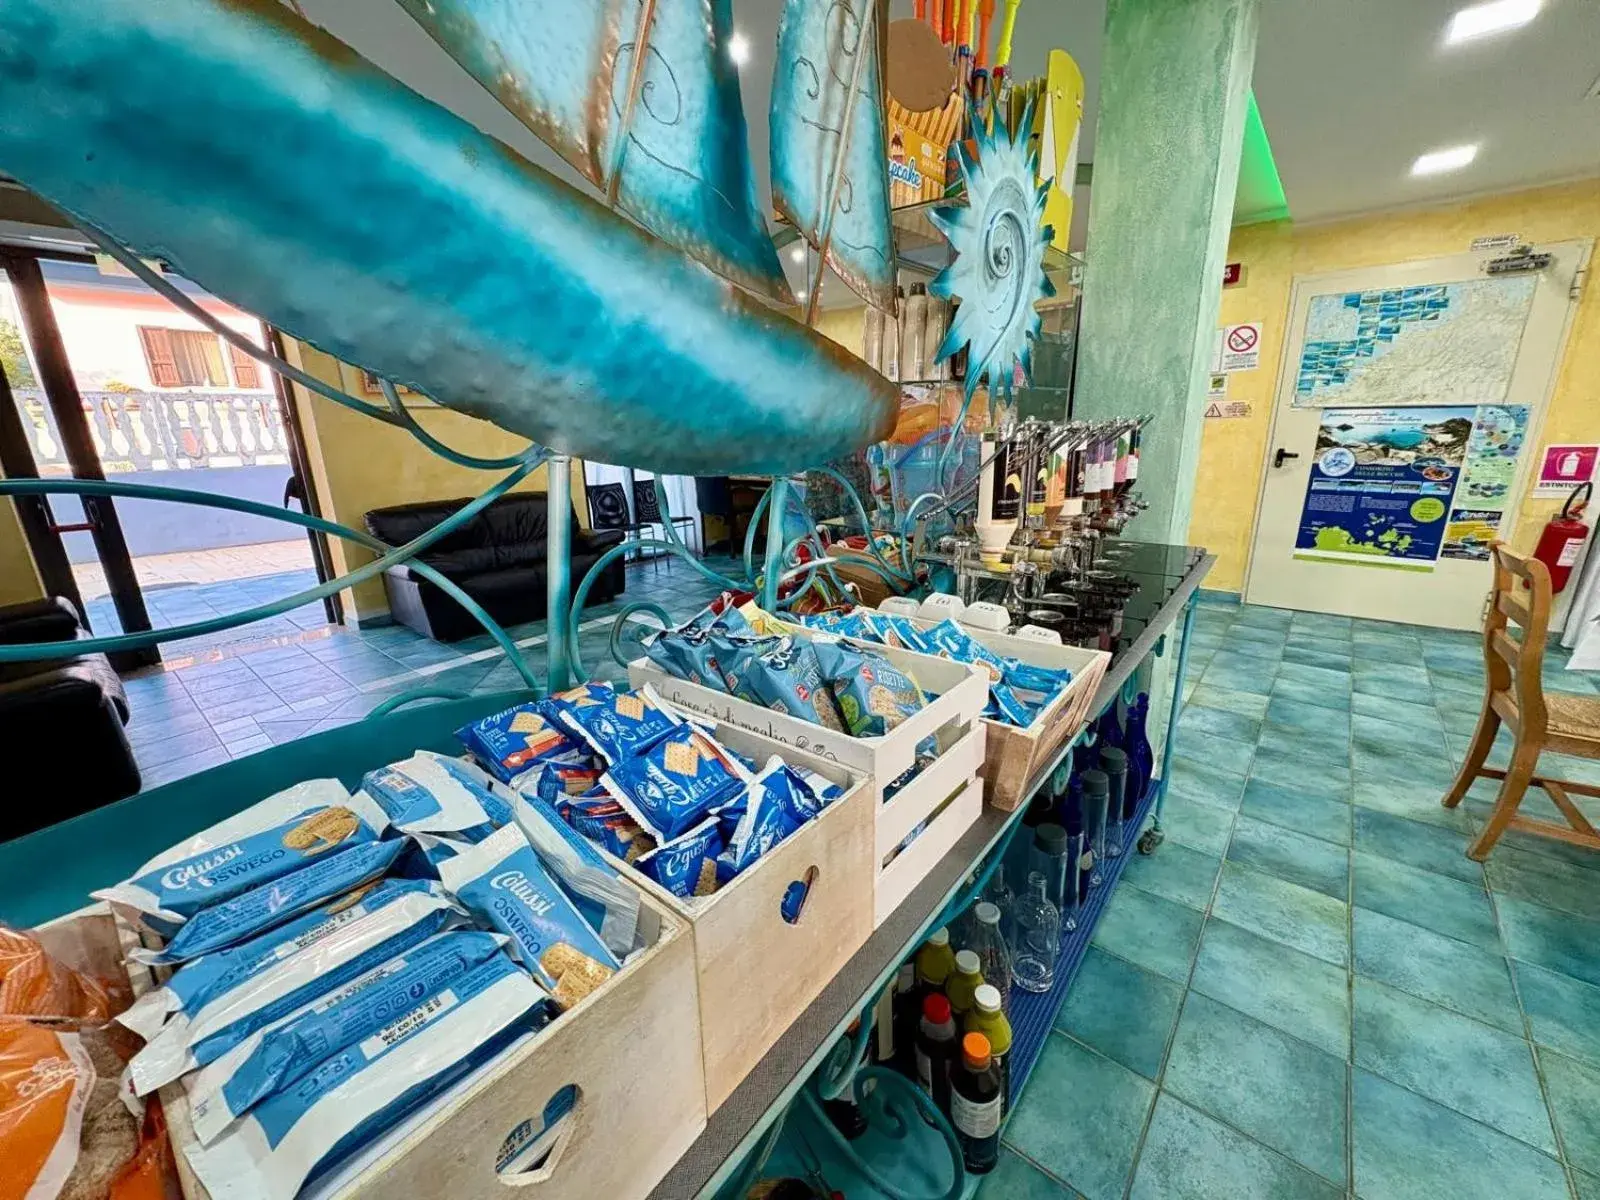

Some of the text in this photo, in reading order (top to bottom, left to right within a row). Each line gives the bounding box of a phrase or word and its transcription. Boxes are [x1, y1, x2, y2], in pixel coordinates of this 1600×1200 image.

[160, 844, 245, 890] Colussi
[489, 870, 556, 916] Colussi
[494, 897, 541, 955] OSWEGO
